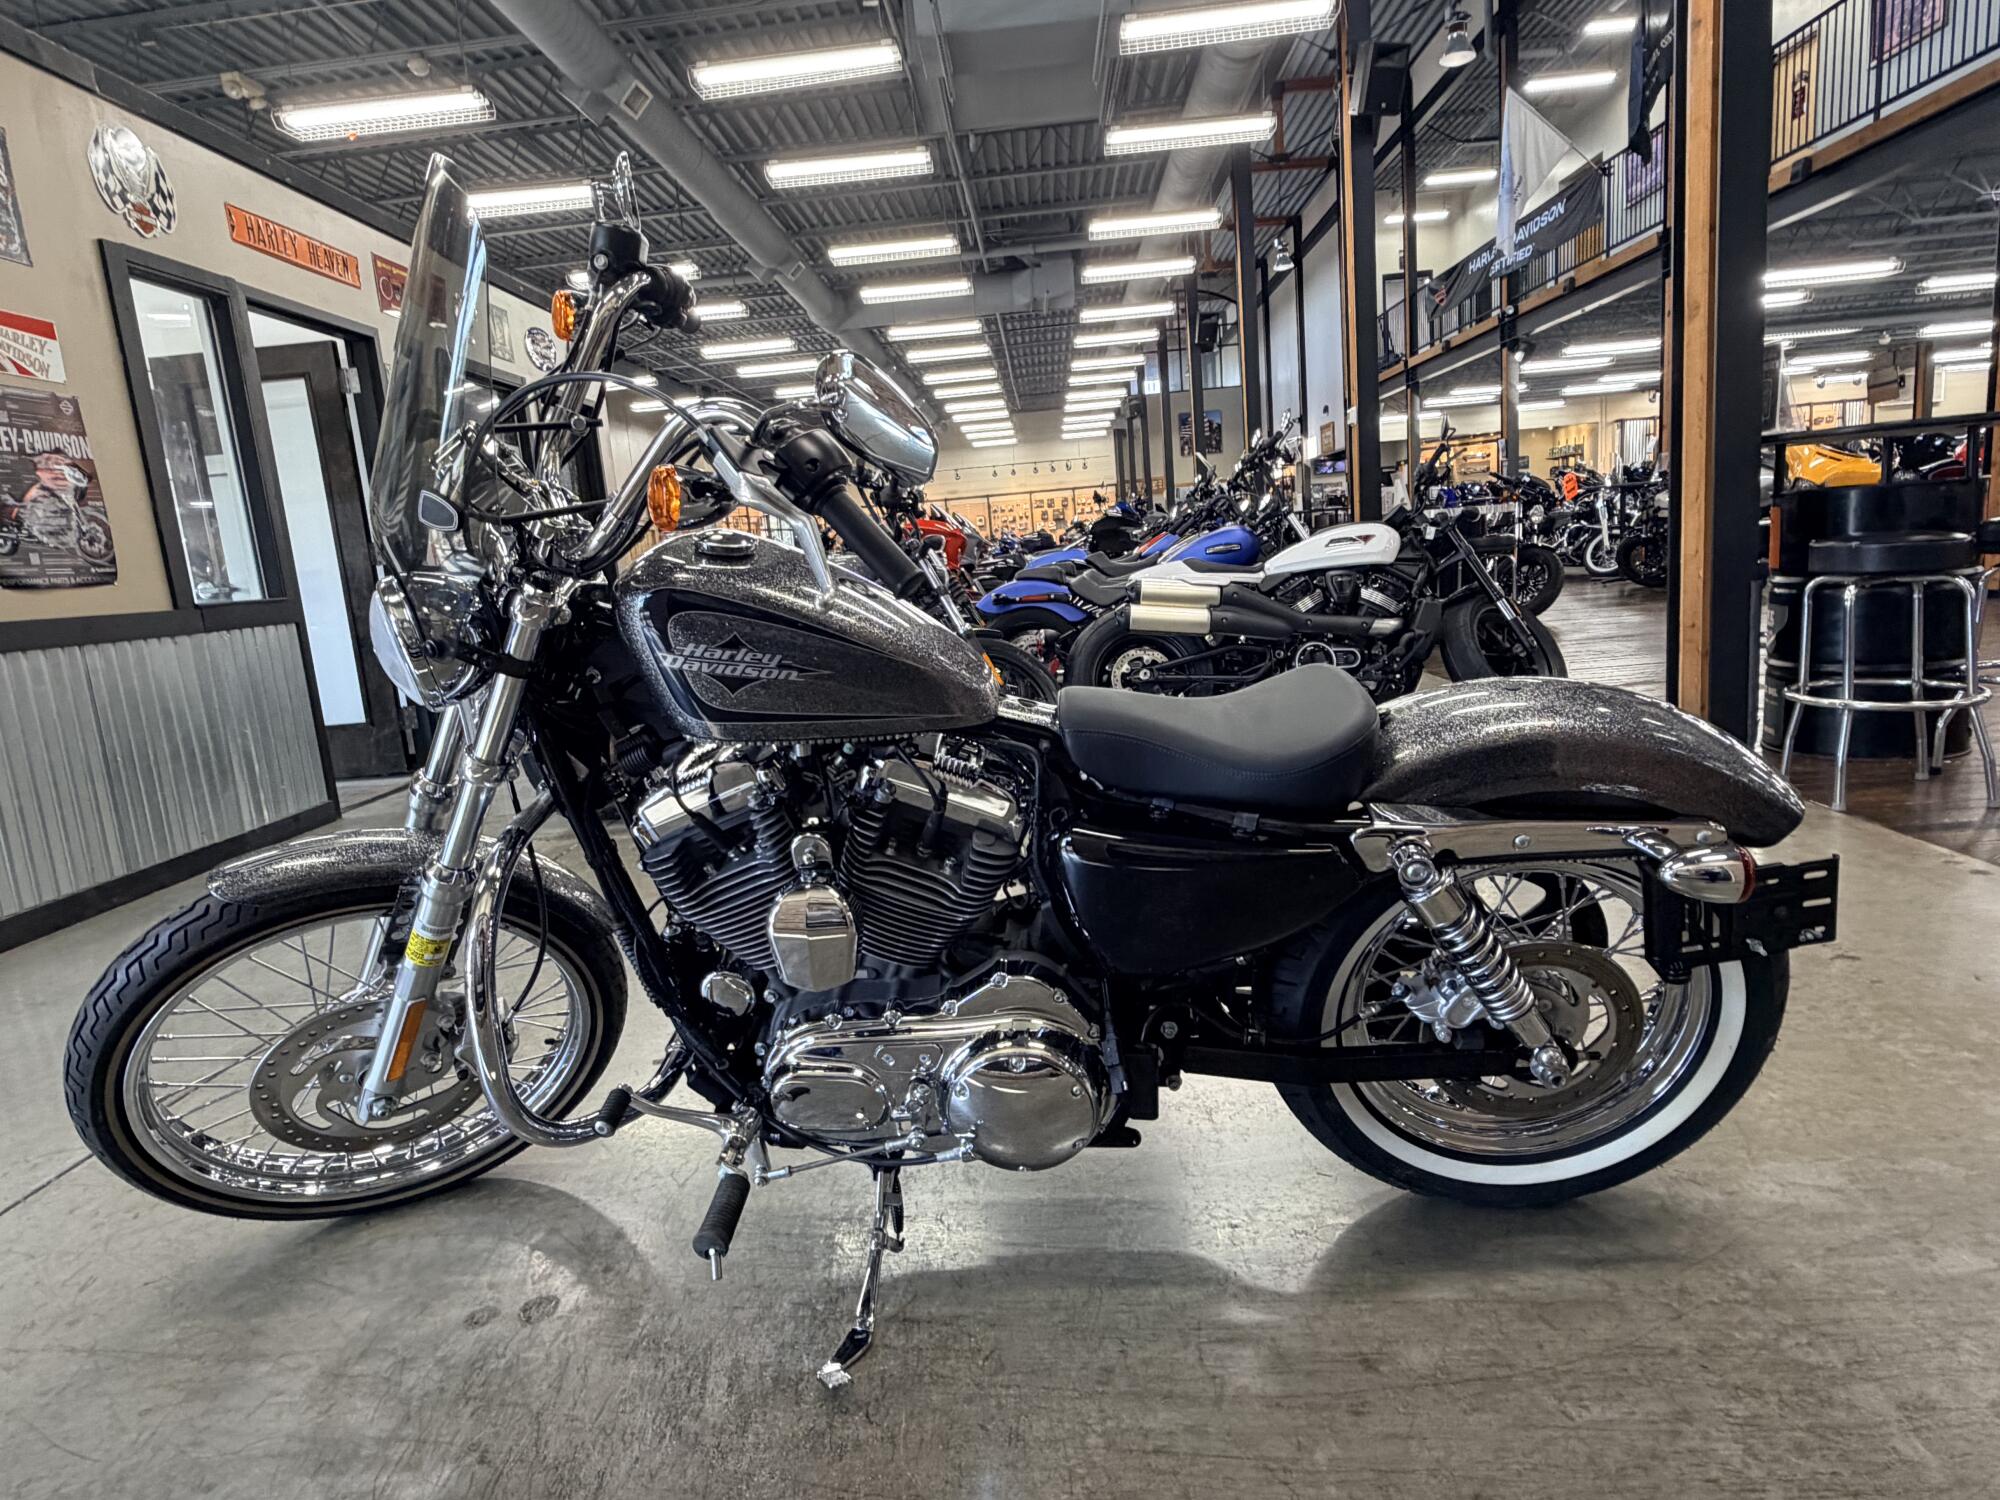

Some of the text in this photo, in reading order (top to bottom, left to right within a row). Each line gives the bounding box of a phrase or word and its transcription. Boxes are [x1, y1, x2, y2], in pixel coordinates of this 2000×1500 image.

[244, 212, 352, 282] HARLEY HEAVEN
[658, 651, 806, 681] Davidson
